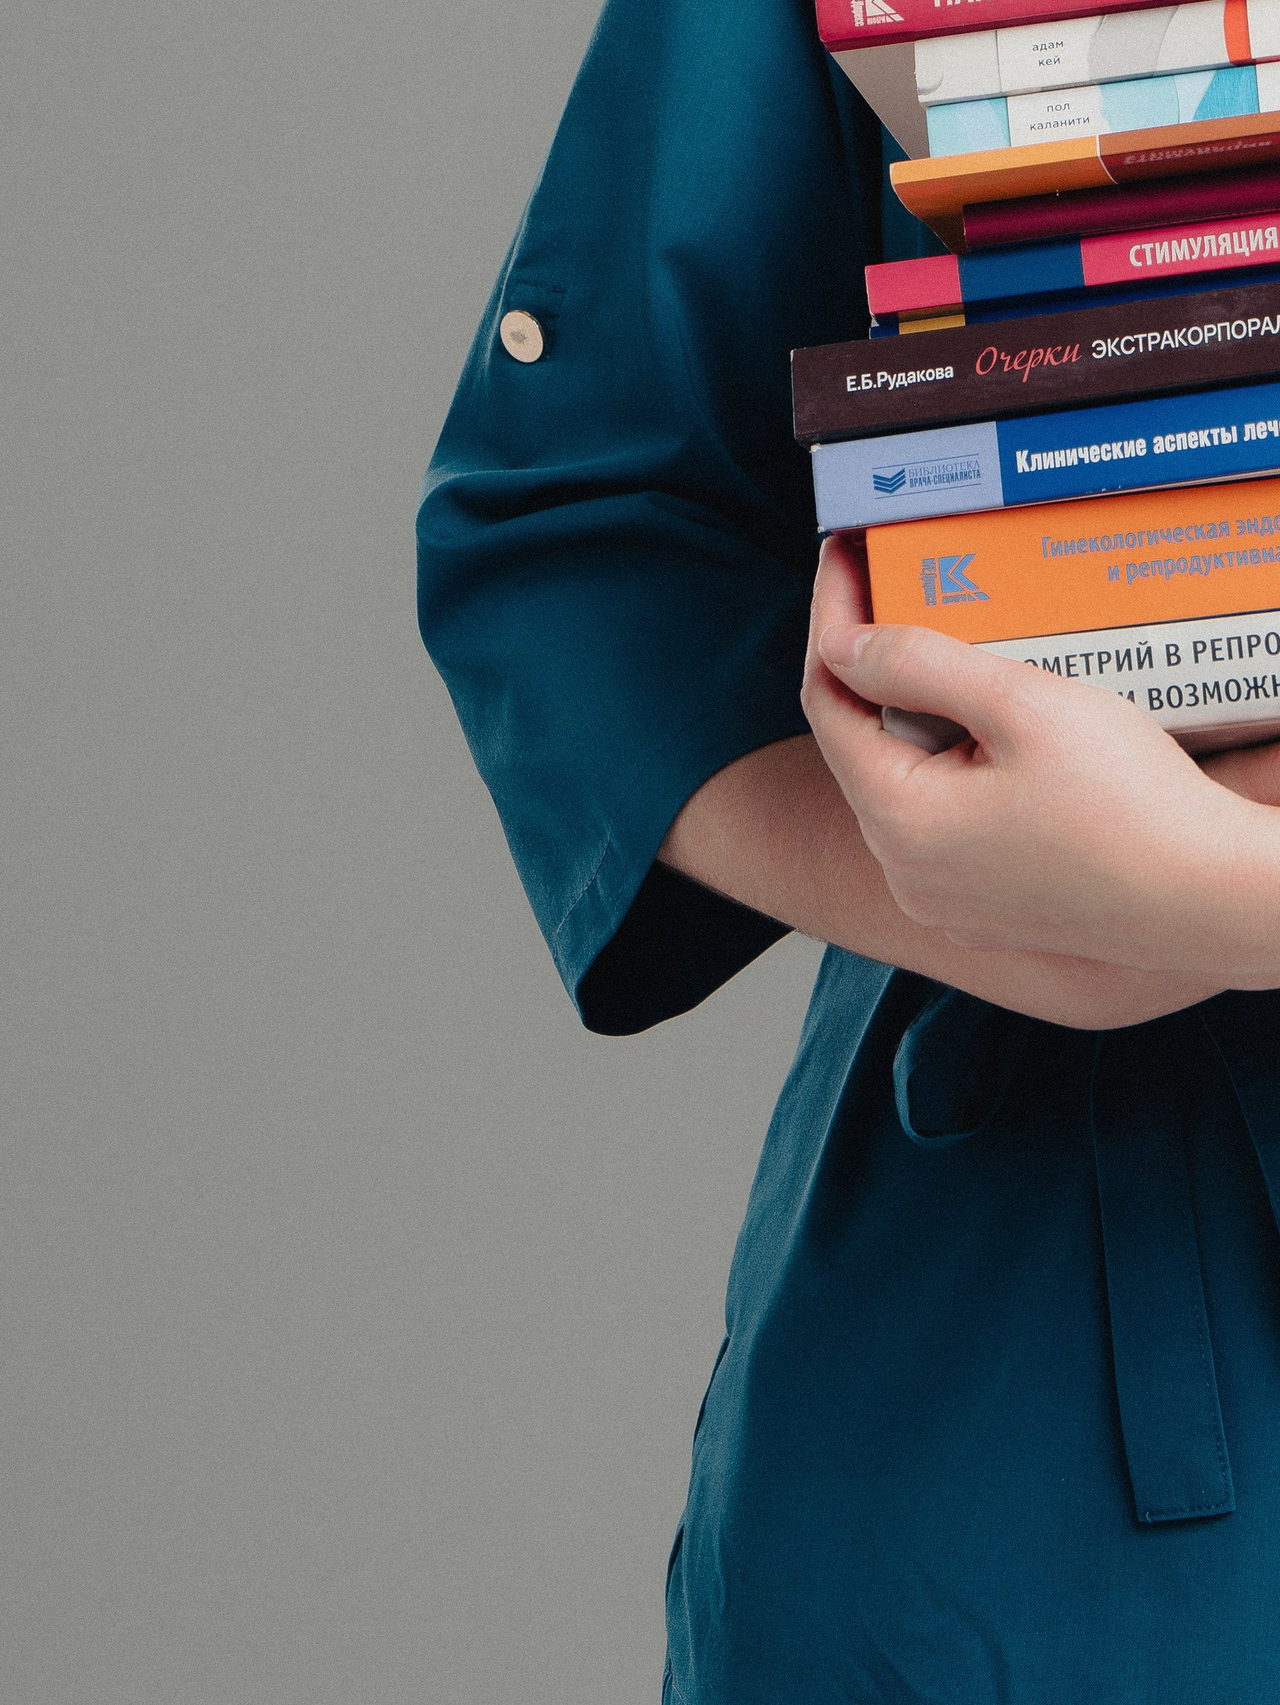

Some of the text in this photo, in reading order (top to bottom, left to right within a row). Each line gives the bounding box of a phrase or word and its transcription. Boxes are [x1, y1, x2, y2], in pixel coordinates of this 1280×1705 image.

[1032, 39, 1064, 53] адам
[1038, 55, 1061, 67] кей
[1046, 103, 1071, 114] пол
[1029, 116, 1091, 133] каланити
[1129, 225, 1279, 268] СТИМУЛЯЦИЯ
[974, 342, 1083, 384] Очерки
[846, 363, 954, 392] Е.Б.Рудакова
[1015, 436, 1147, 474] Клинические
[1153, 424, 1238, 455] аспекты
[908, 460, 980, 478] БИБЛИОТЕКА
[909, 469, 981, 488] ВРАЧА-СПЕЦИАЛИСТА
[1041, 519, 1231, 560] Гинекологическая
[1108, 565, 1120, 582] и
[1166, 643, 1181, 667] В
